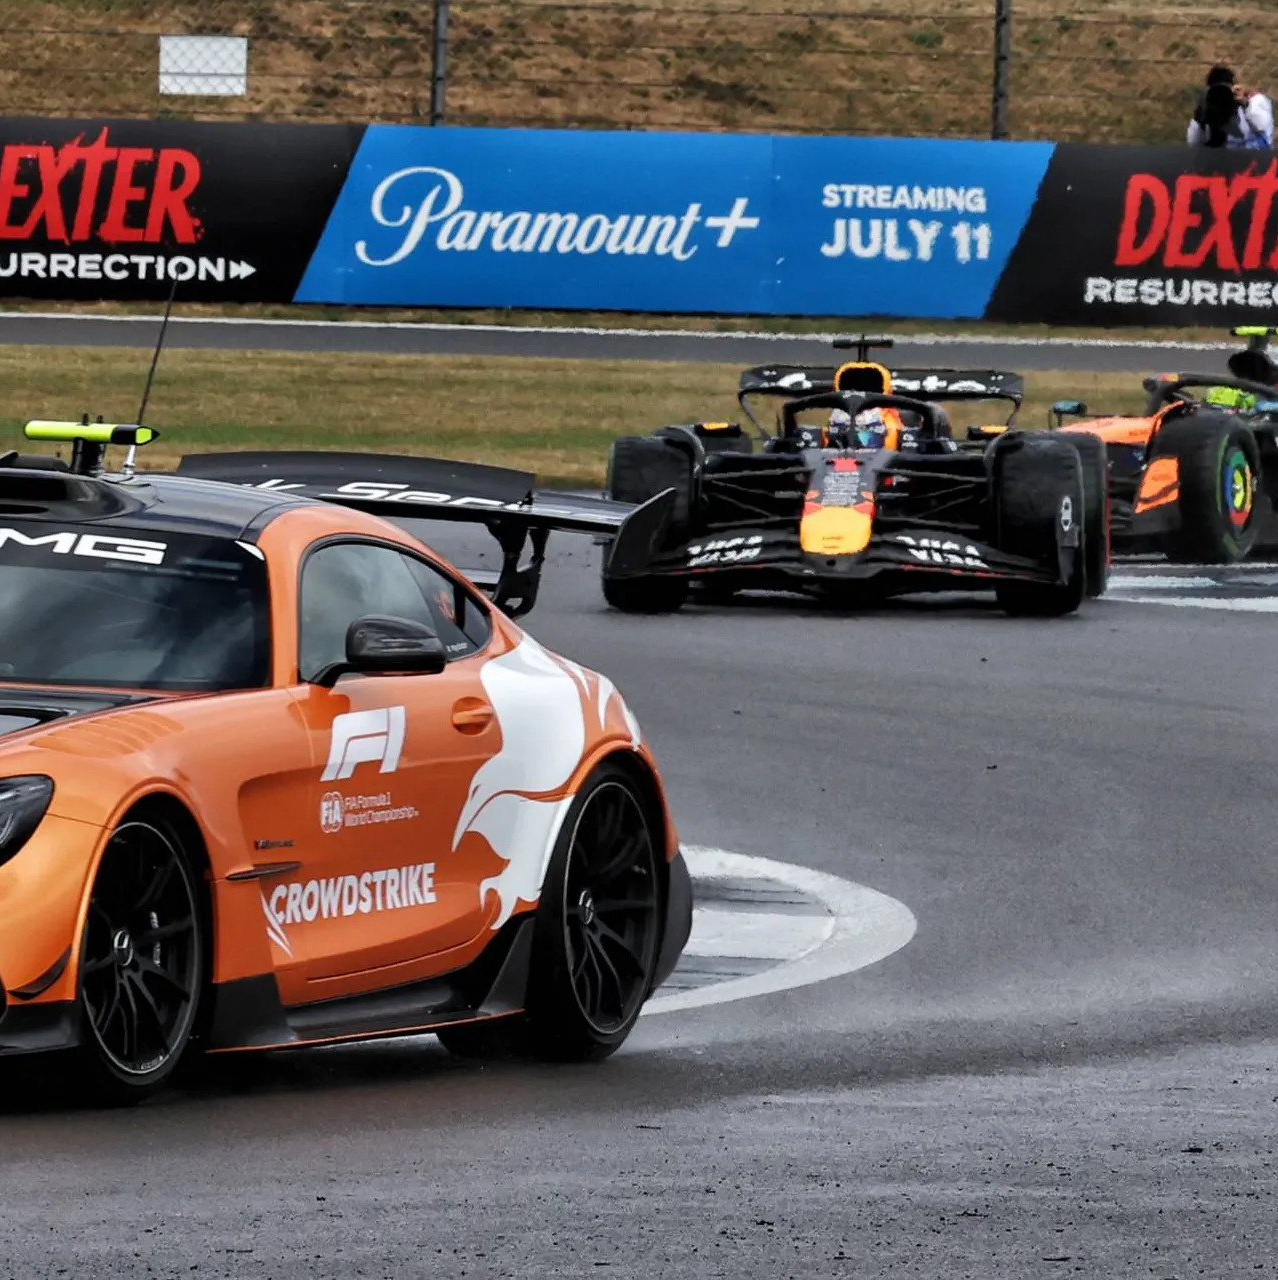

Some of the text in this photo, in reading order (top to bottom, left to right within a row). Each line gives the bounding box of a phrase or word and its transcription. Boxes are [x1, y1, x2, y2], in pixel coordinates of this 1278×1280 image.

[355, 166, 760, 267] Paramount+
[823, 184, 986, 213] STREAMING
[821, 219, 991, 264] JULY 11
[270, 862, 437, 925] CROWDSTRIKE
